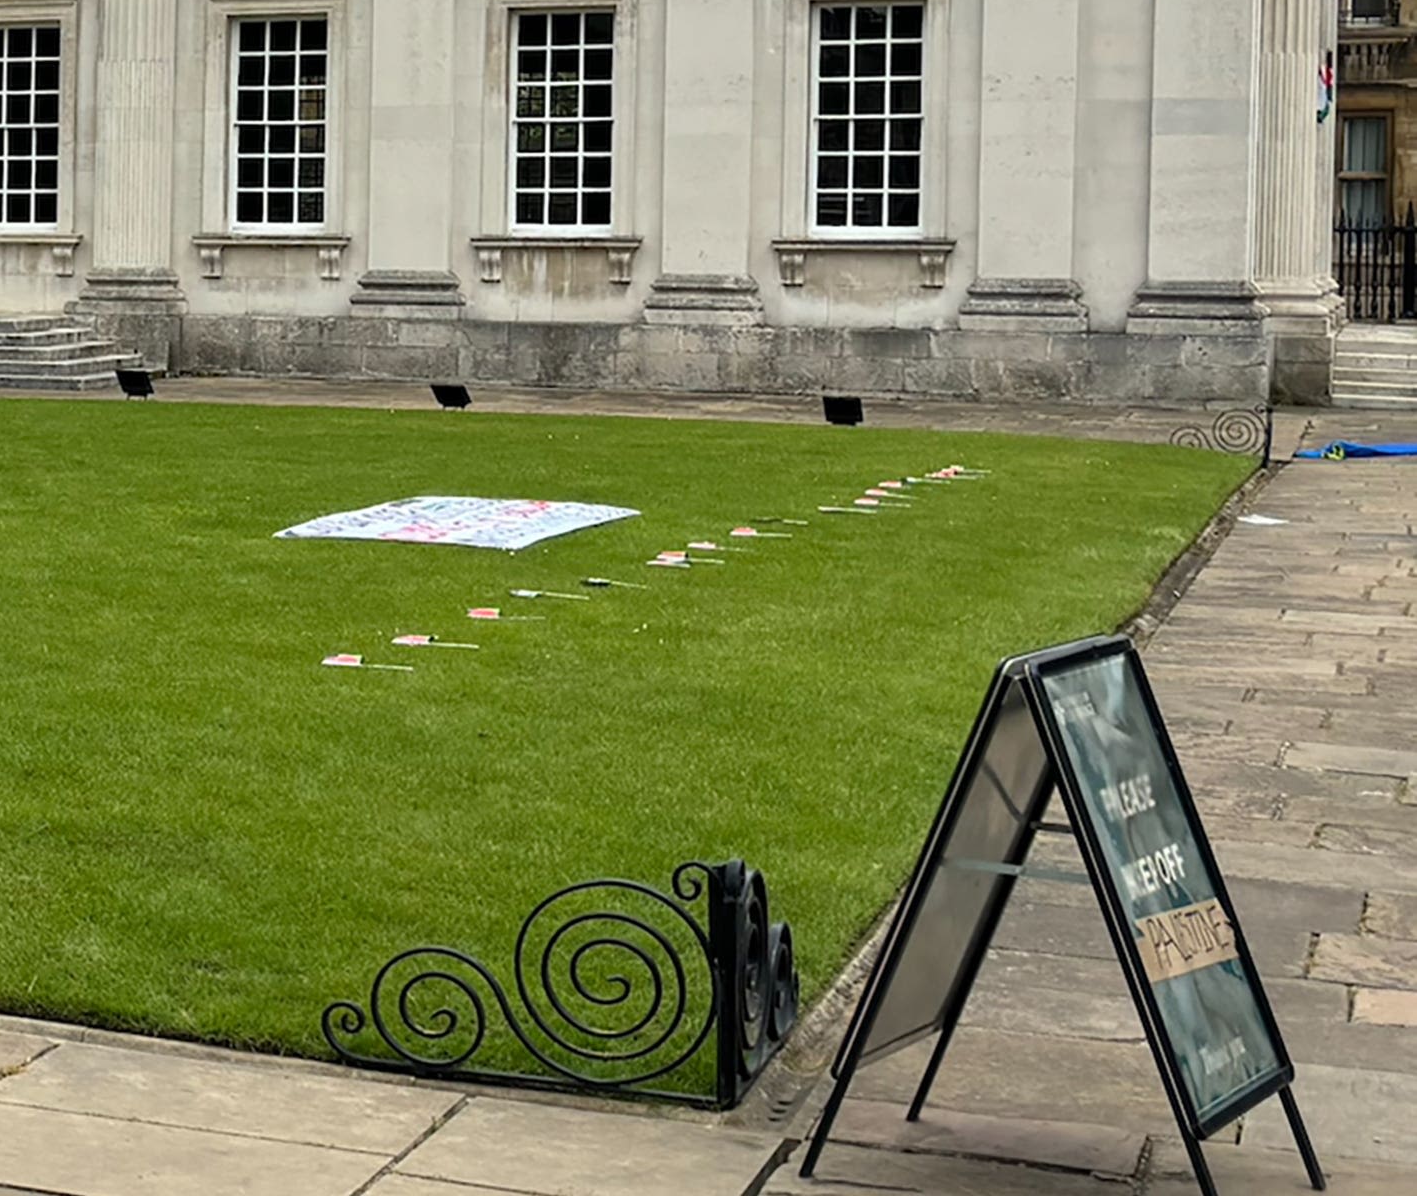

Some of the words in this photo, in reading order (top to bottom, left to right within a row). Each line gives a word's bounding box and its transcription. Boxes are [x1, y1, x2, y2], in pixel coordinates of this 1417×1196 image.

[1099, 773, 1156, 820] PLEASE
[1154, 843, 1185, 884] OFF
[1146, 905, 1230, 971] PALESTINE
